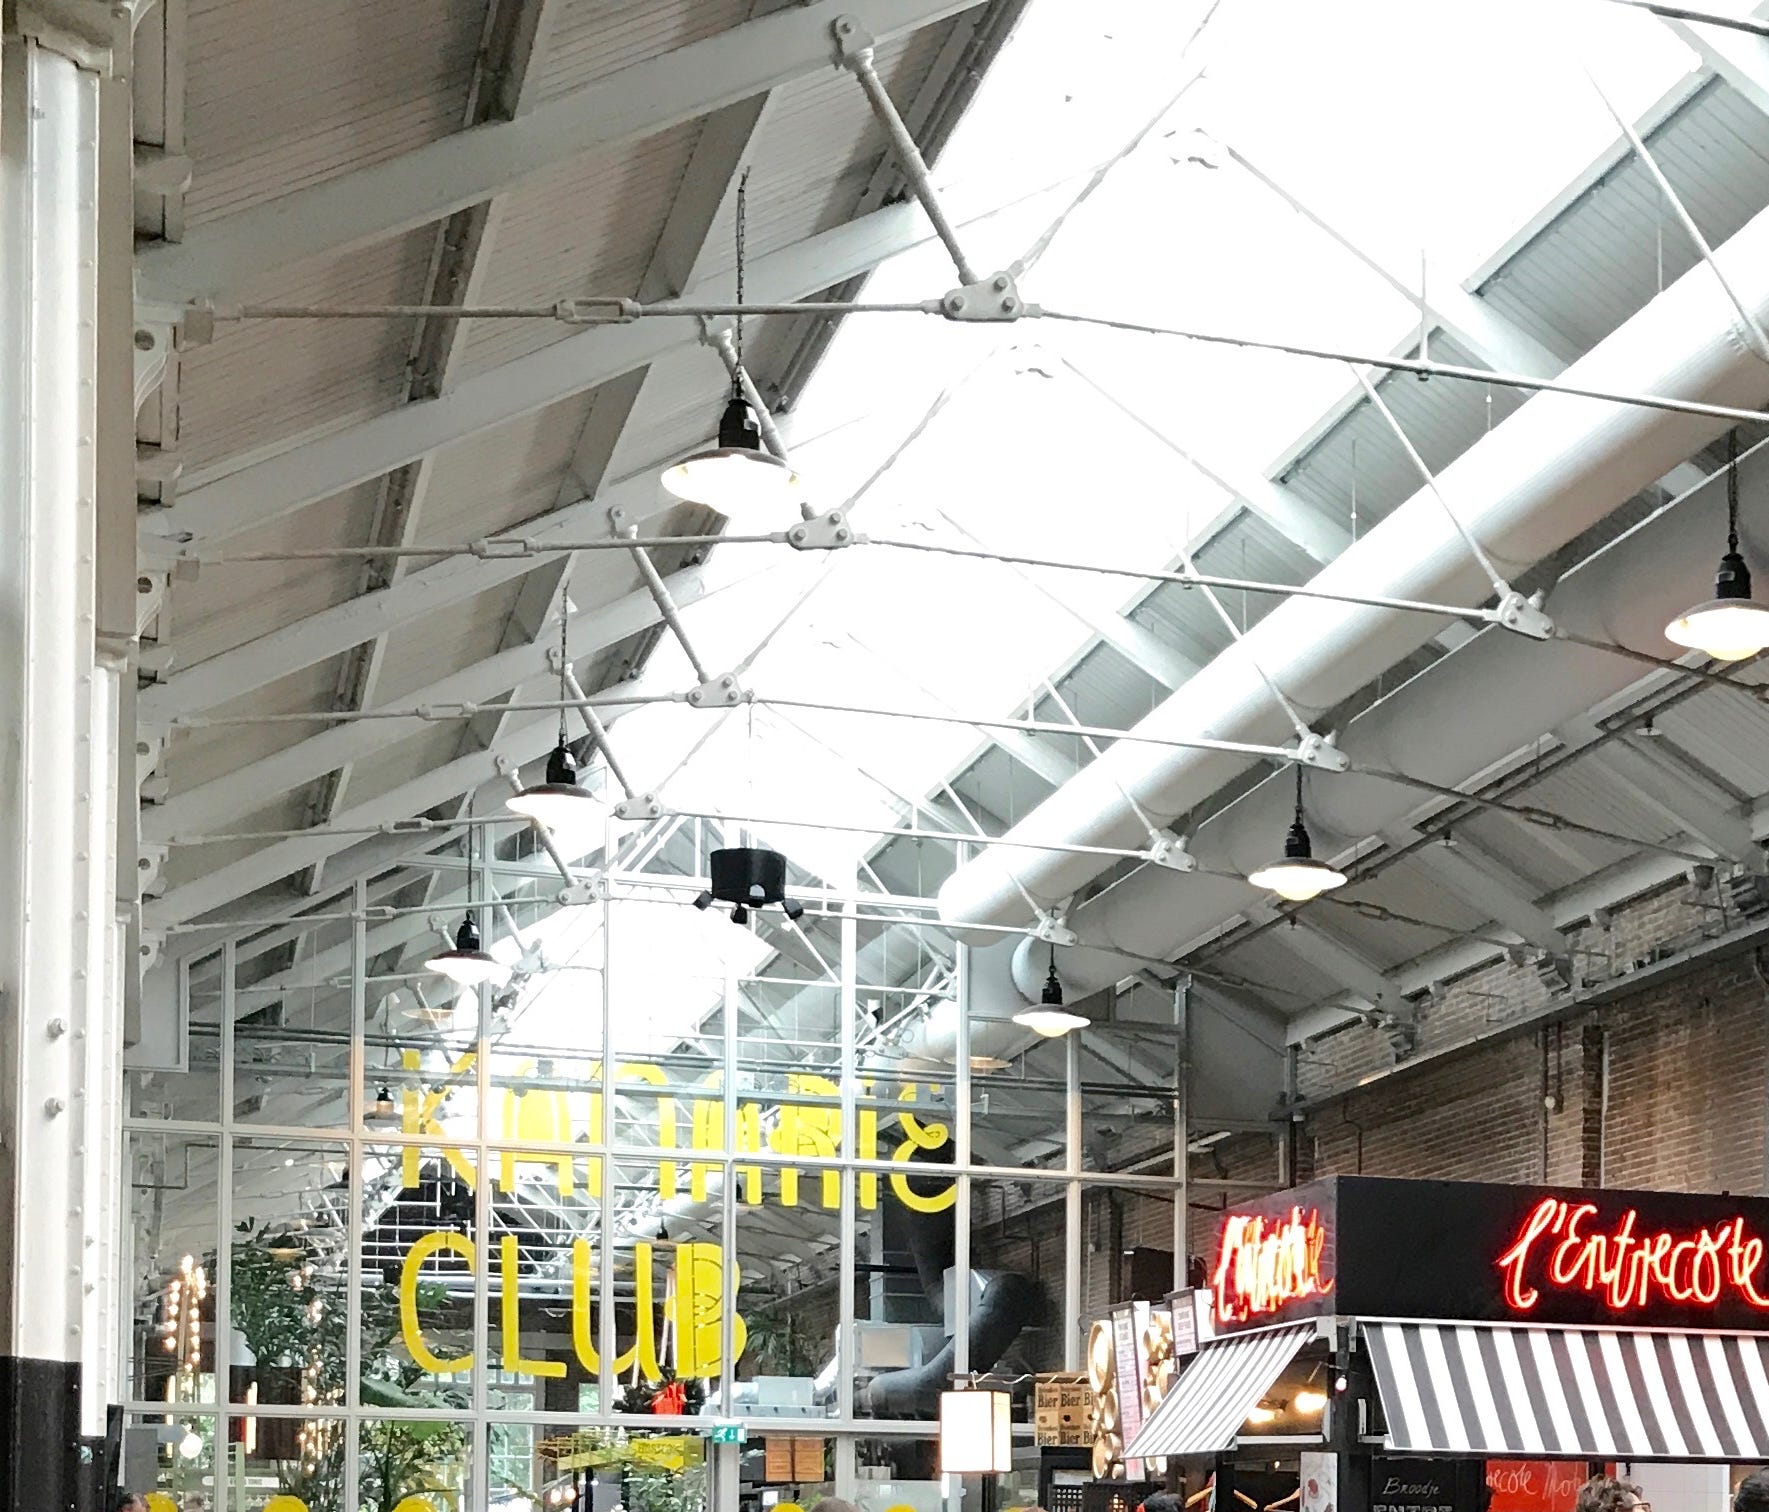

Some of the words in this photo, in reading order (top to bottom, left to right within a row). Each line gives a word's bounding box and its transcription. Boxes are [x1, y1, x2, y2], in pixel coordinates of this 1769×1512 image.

[399, 1231, 748, 1381] CLUB
[1060, 1393, 1081, 1408] Bier
[1382, 1476, 1440, 1498] Broodje
